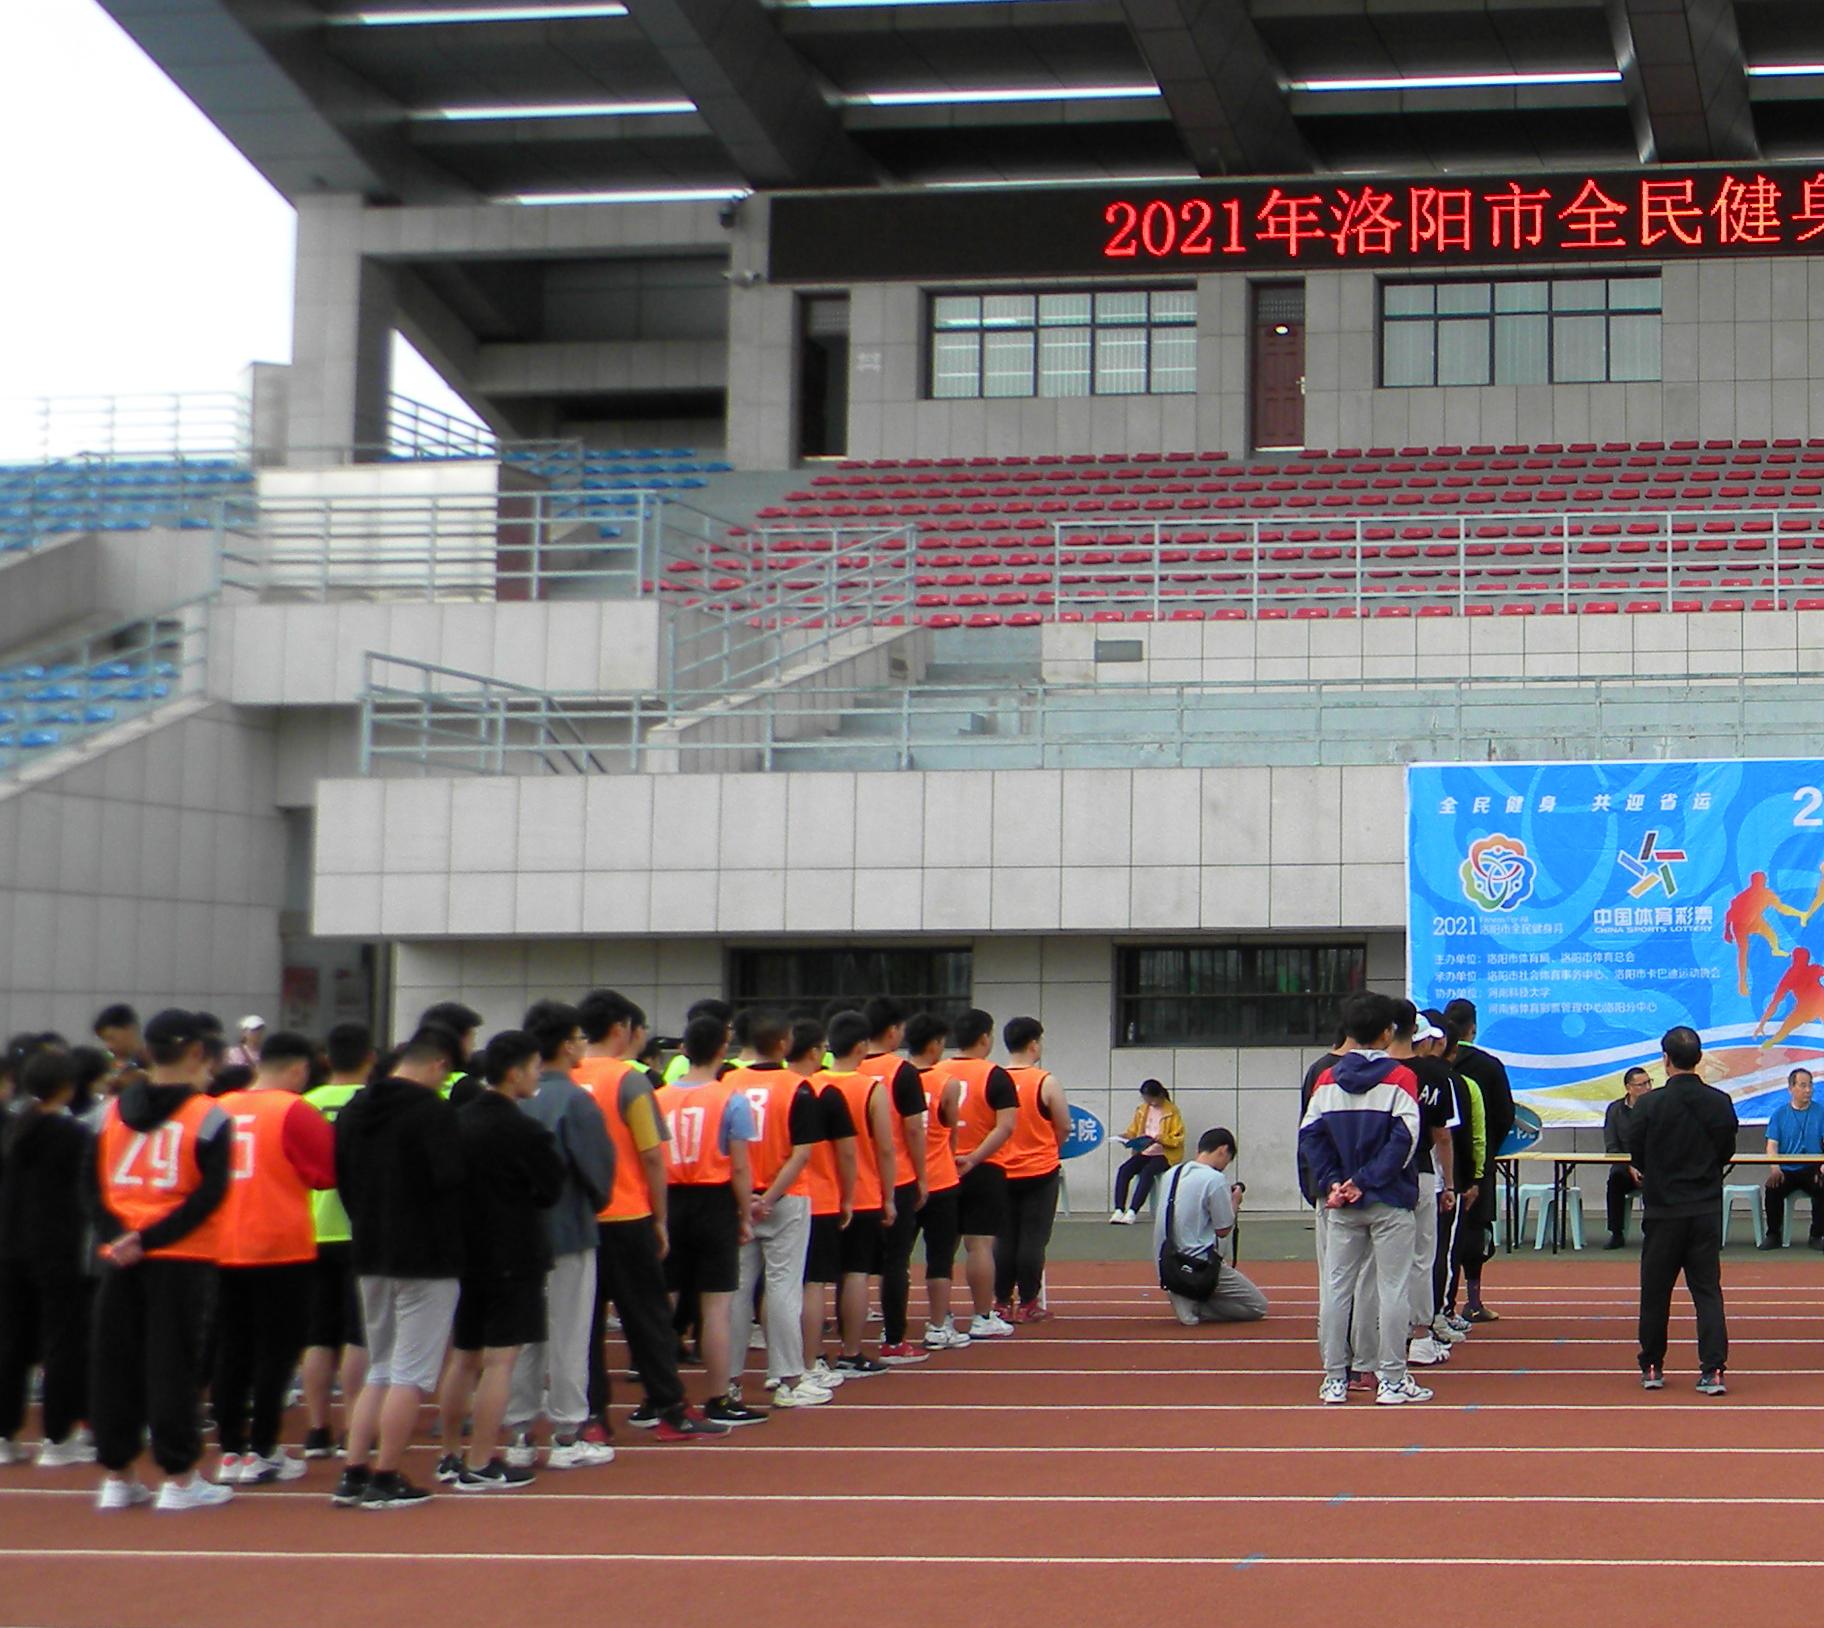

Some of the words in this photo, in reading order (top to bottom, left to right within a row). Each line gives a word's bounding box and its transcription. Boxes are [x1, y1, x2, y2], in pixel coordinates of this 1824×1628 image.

[1433, 916, 1477, 936] 2021
[1594, 906, 1713, 927] 中国体育彩票
